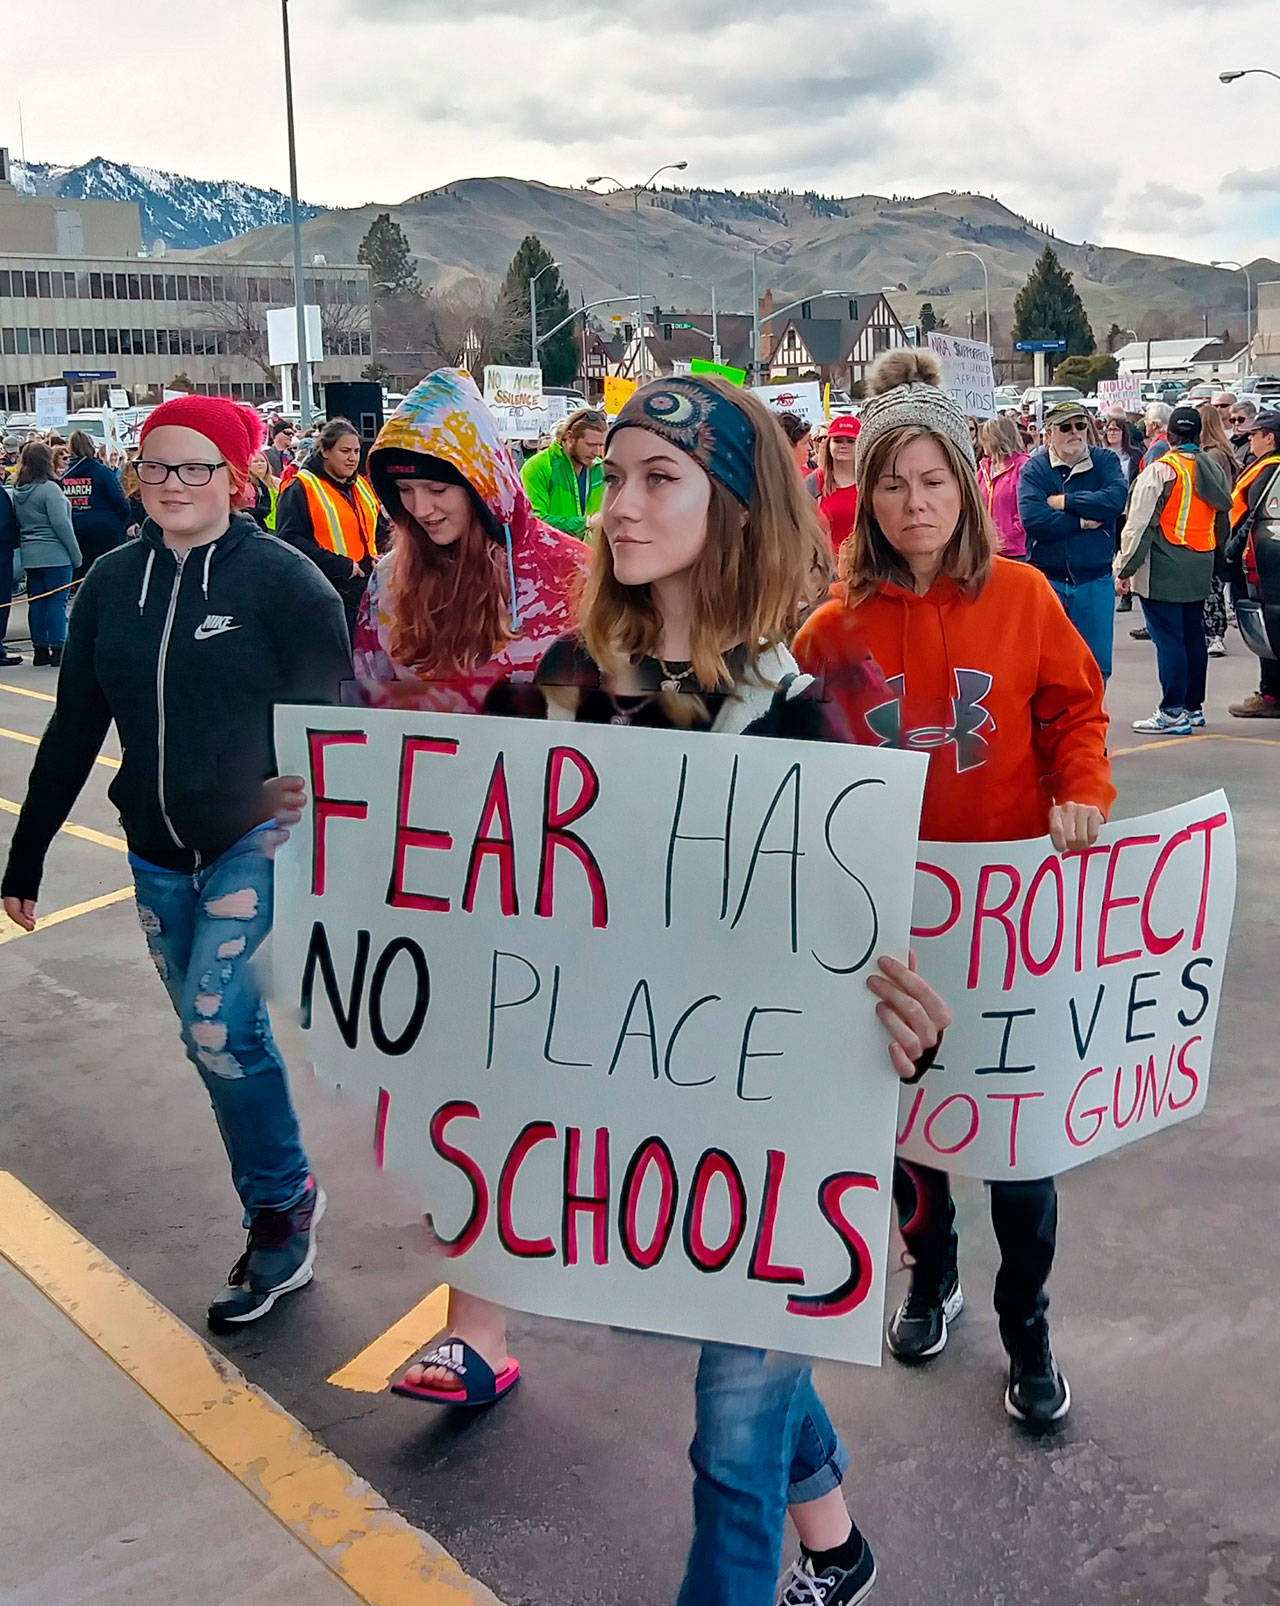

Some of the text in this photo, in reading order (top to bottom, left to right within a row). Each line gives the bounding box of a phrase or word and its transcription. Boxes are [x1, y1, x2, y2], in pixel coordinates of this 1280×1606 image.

[63, 485, 92, 495] MARCH
[202, 615, 234, 629] NIKE
[305, 727, 886, 975] FEAR HAS
[300, 921, 803, 1101] NO PLACE
[927, 957, 1214, 1075] IVES
[1064, 1036, 1202, 1147] GUNS
[423, 1099, 880, 1318] SCHOOLS
